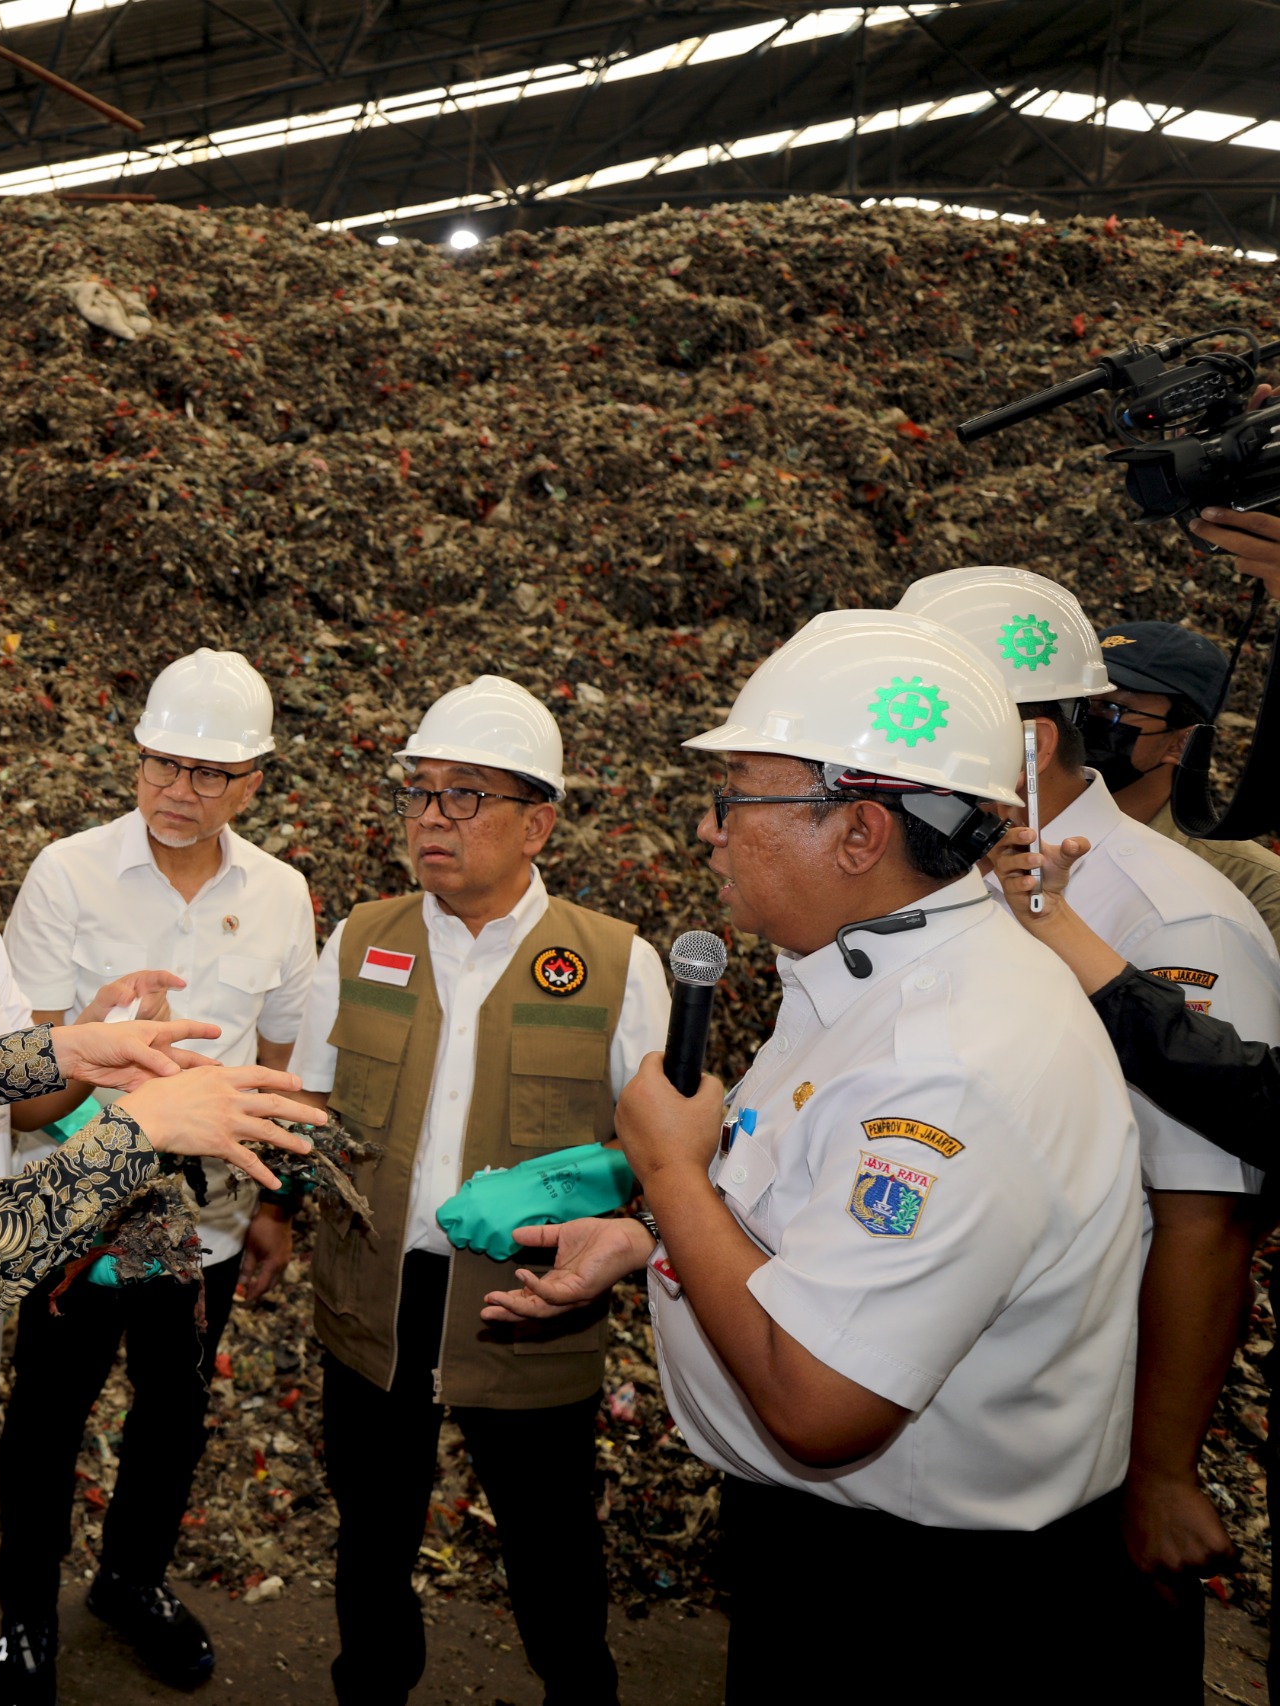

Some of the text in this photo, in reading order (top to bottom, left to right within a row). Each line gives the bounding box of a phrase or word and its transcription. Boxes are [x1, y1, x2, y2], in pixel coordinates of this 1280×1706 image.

[1173, 970, 1210, 985] JAKARTA
[1185, 1003, 1205, 1012] AYA
[868, 1120, 902, 1136] PEMPROV
[864, 1156, 928, 1188] JAYA RAYA
